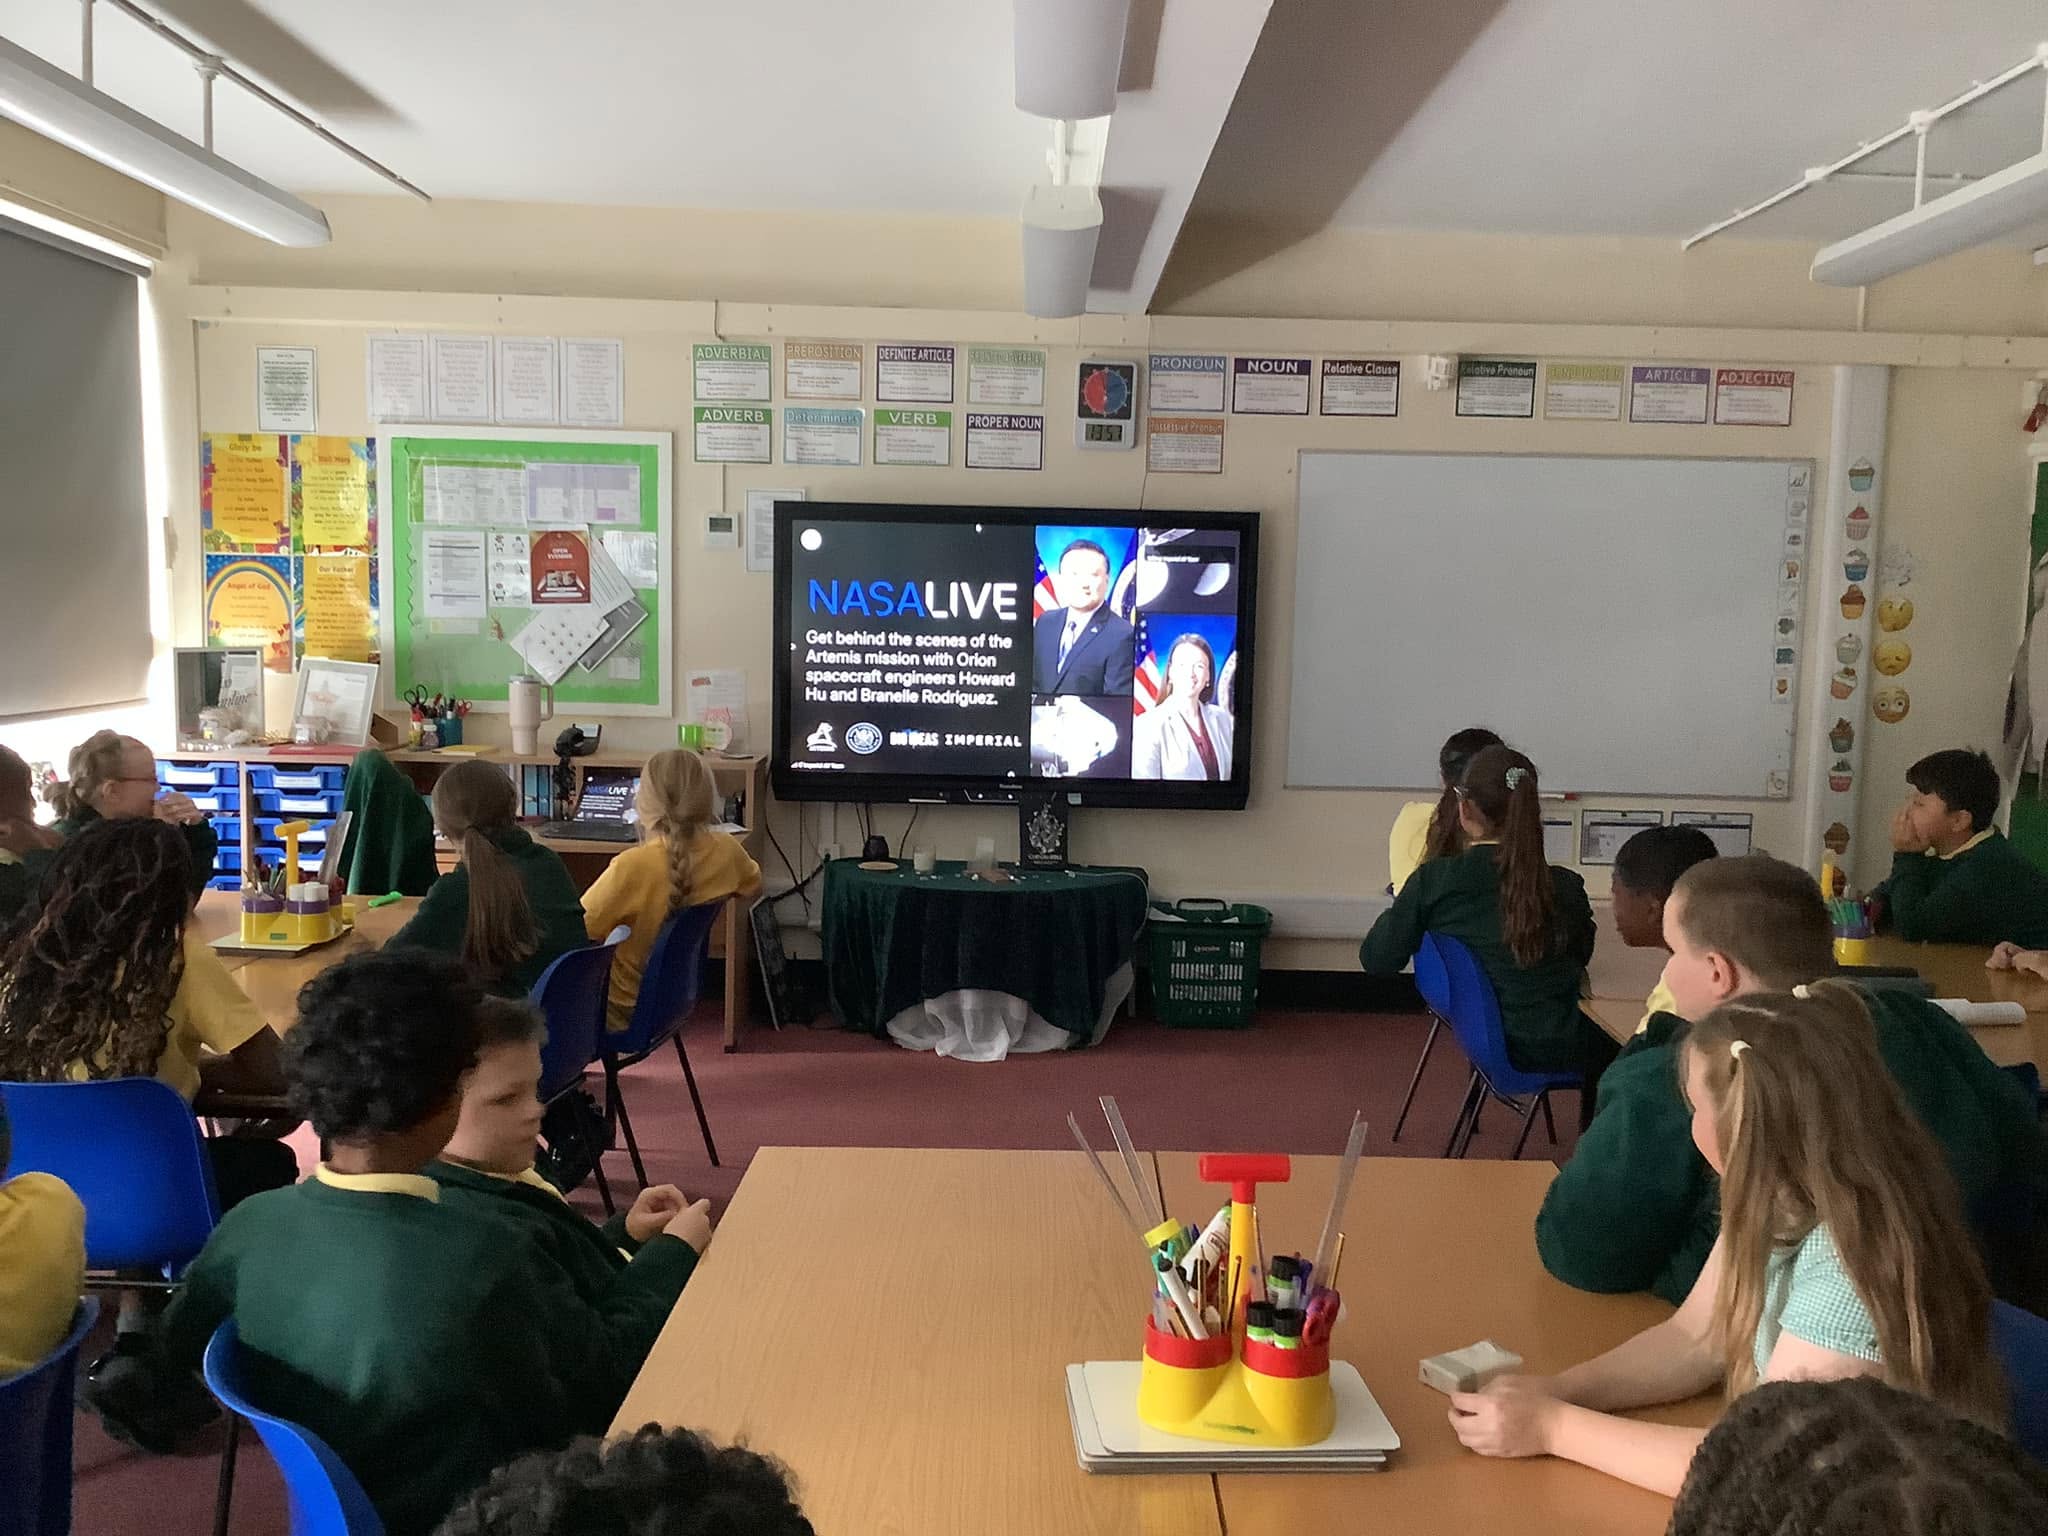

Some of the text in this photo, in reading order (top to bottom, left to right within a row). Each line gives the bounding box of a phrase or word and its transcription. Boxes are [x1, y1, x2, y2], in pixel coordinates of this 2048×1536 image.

[696, 347, 769, 360] ADVERBIAL
[787, 345, 861, 359] PREPOSITION
[879, 347, 953, 362] DEFINITE ARTICLE
[1151, 357, 1224, 370] PRONOUN
[1247, 360, 1298, 374] NOUN
[1323, 362, 1398, 375] Relative Clause
[1497, 363, 1534, 377] Pronoun
[1645, 369, 1697, 382] ARTICLE
[1719, 372, 1793, 385] ADJECTIVE
[702, 408, 765, 422] ADVERB
[786, 410, 860, 424] Determiners
[889, 412, 938, 425] VERB
[968, 415, 1042, 430] PROPER NOUN
[805, 630, 1013, 649] Get behind the scenes of the
[805, 649, 997, 668] Artemis mission with Orion
[805, 669, 1016, 687] spacecraft engineers Howard
[805, 687, 999, 708] Hu and Branelle Rodriguez.
[944, 733, 1022, 748] IMPERIAL
